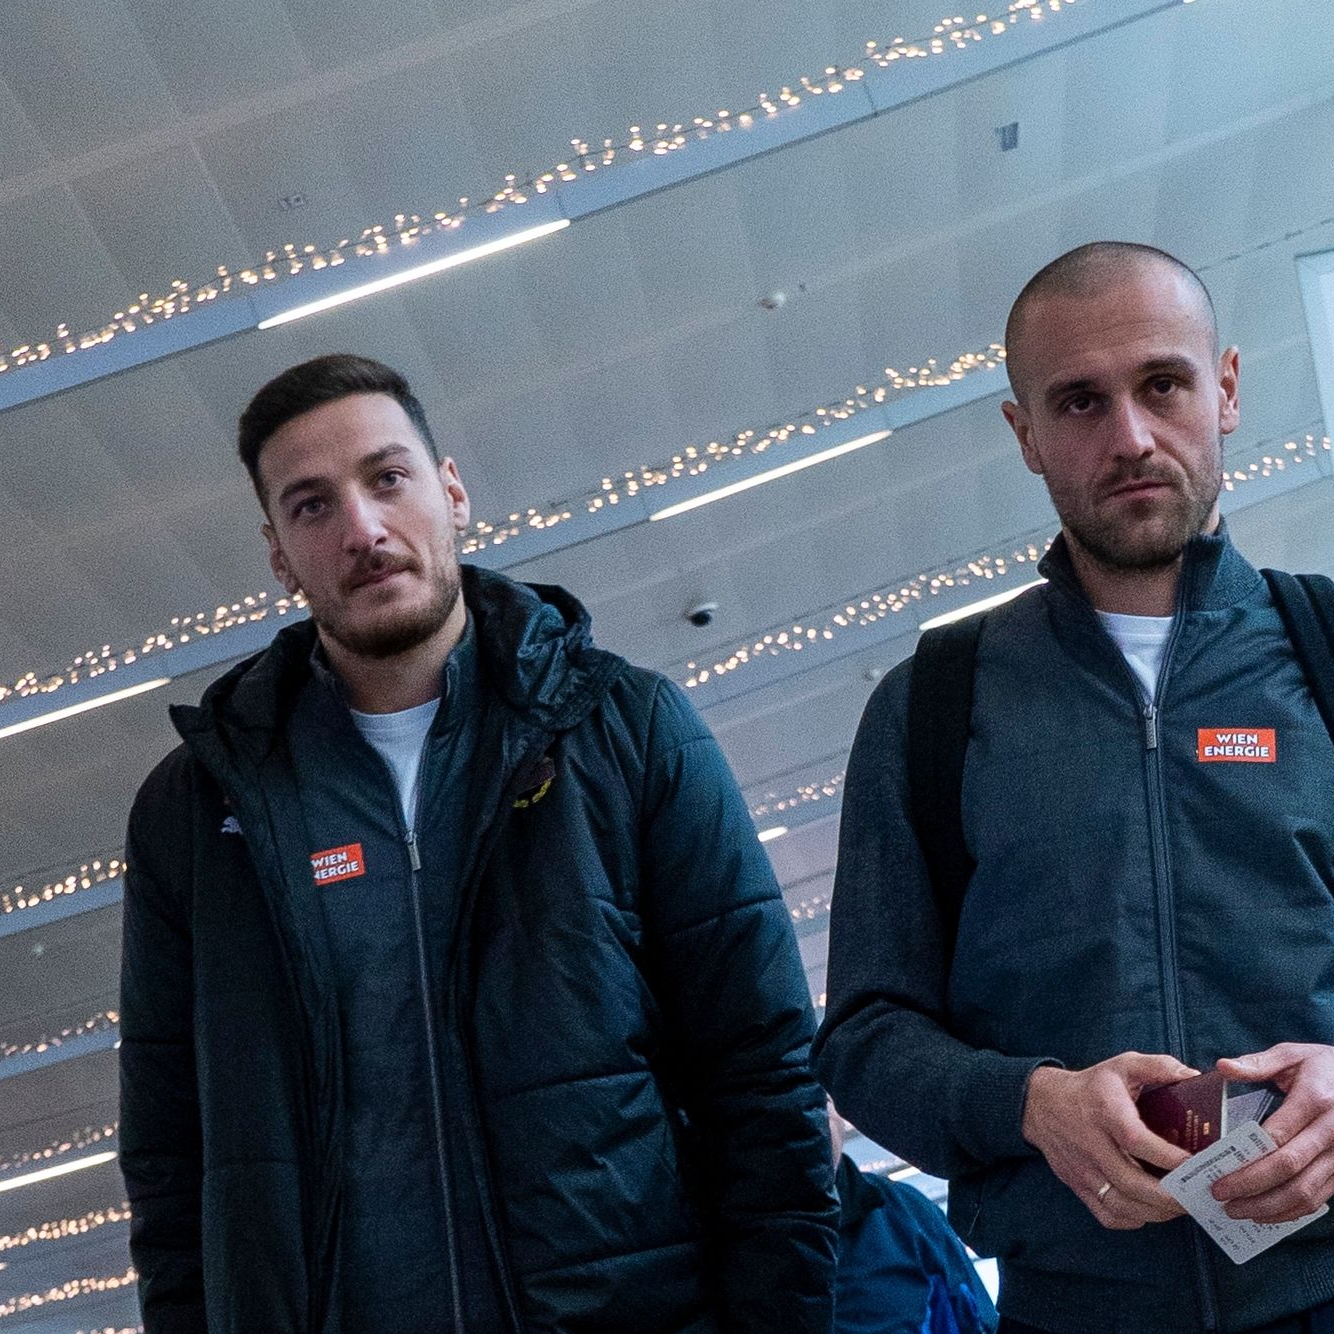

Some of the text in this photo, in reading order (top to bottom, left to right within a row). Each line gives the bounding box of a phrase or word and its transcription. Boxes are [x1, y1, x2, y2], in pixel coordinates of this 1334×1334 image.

[1215, 733, 1259, 745] WIEN
[1204, 745, 1270, 758] ENERGIE
[310, 851, 348, 868] WIEN
[314, 860, 360, 880] NERGIE
